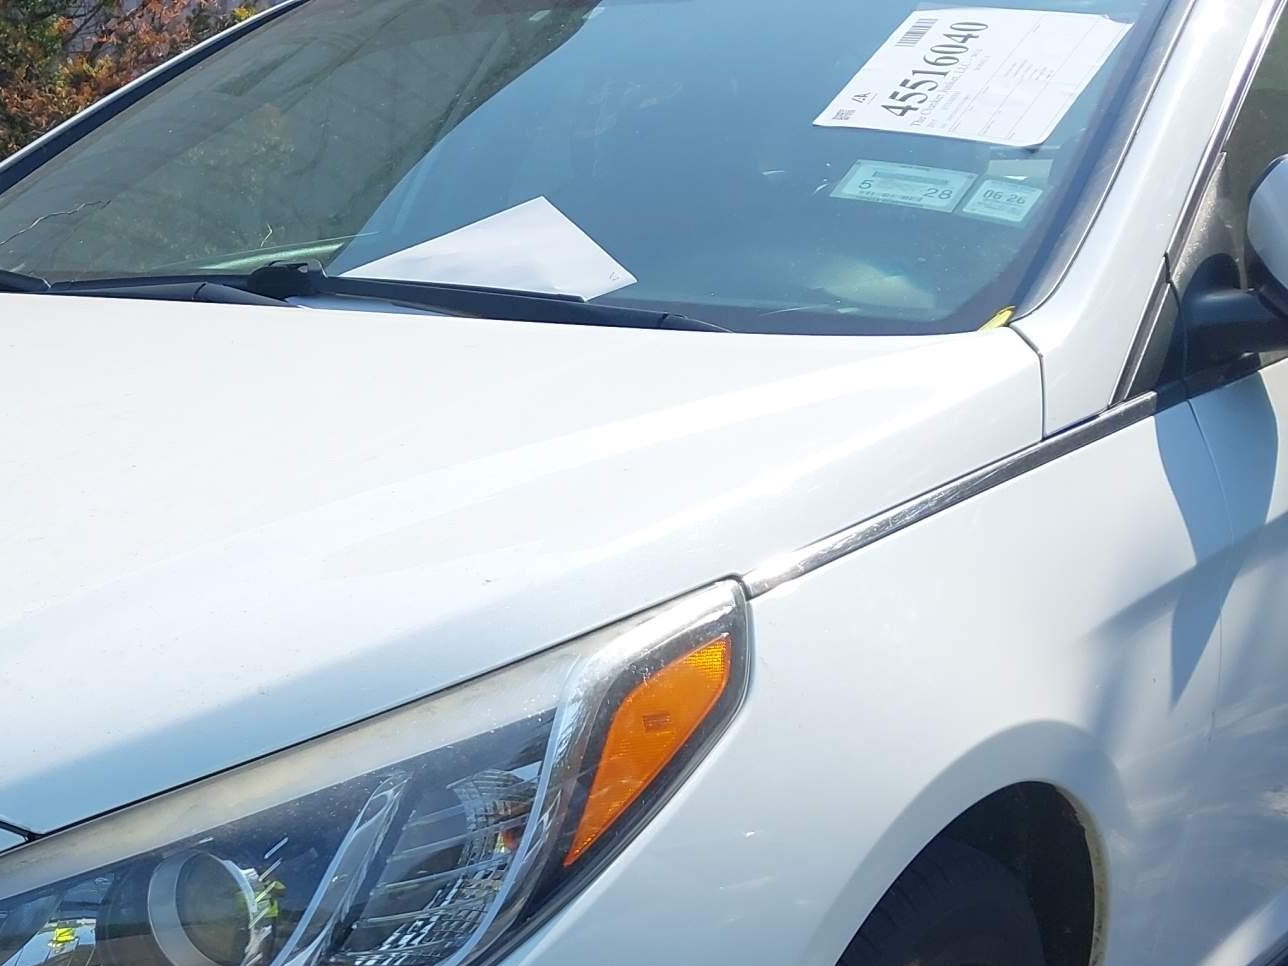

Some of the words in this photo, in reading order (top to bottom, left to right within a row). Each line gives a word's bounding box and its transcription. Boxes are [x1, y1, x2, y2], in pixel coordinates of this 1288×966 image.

[881, 22, 989, 116] 45516040
[858, 179, 874, 190] 5
[922, 187, 953, 200] 28
[983, 189, 1003, 200] 06
